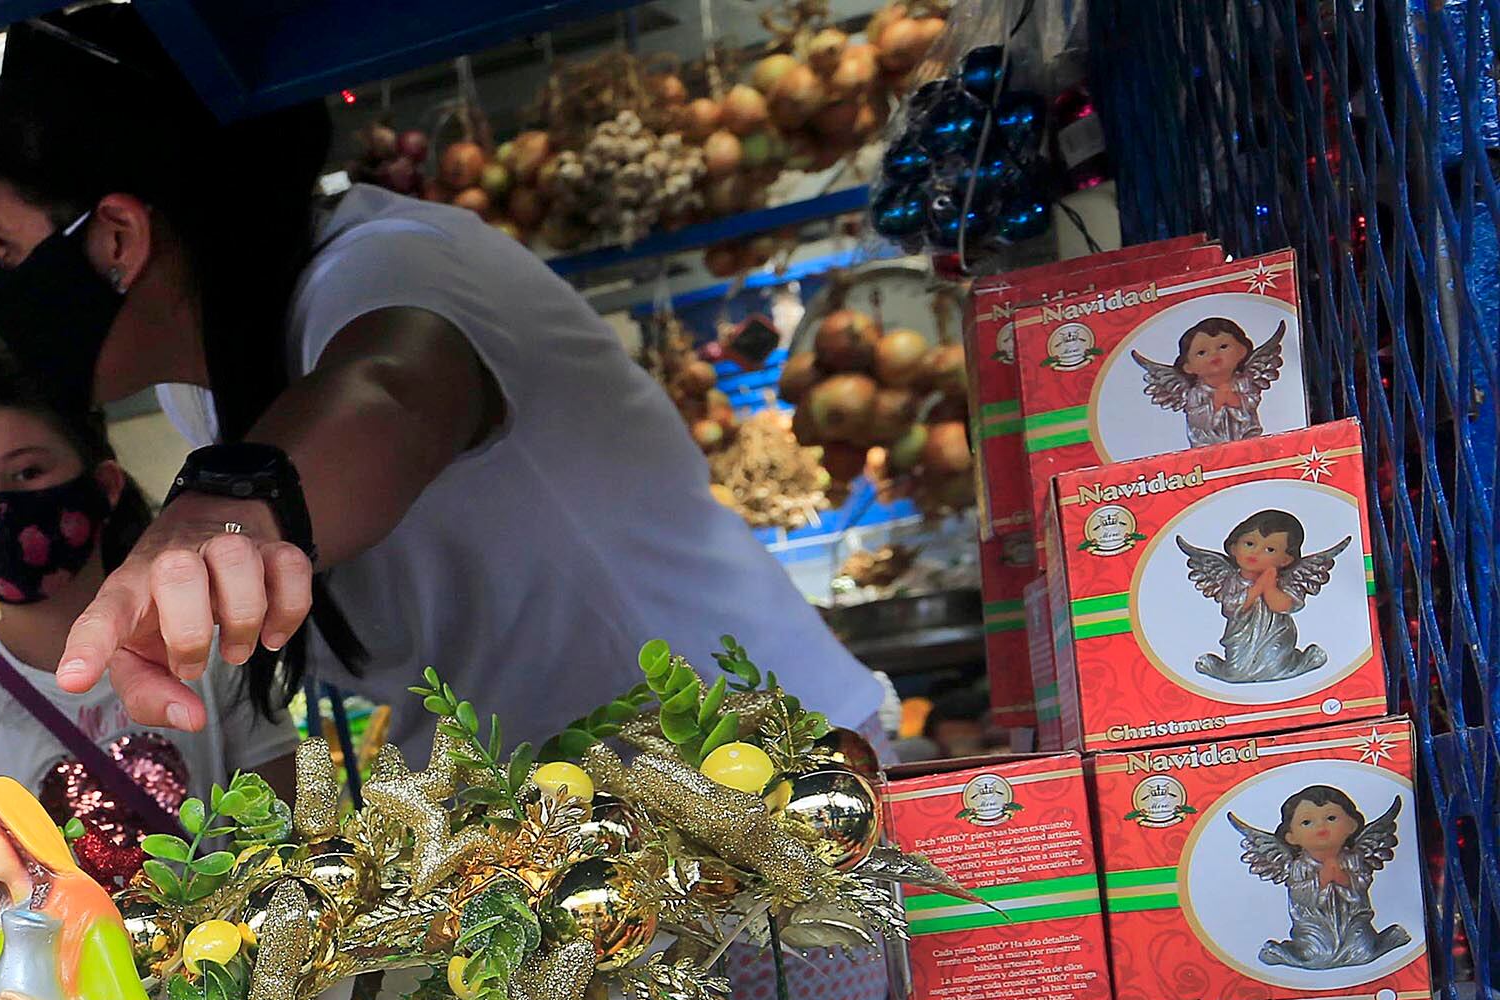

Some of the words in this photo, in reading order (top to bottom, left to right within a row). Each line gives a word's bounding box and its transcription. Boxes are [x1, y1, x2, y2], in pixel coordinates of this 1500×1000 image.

[1041, 281, 1158, 325] Navidad
[1077, 464, 1205, 506] Navidad
[1105, 716, 1226, 742] Christmas
[1125, 739, 1259, 775] Navidad
[915, 839, 936, 847] Each
[971, 831, 993, 841] piece
[1008, 827, 1029, 835] been
[952, 844, 963, 853] by
[964, 841, 985, 850] hand
[986, 840, 997, 849] by
[998, 838, 1012, 846] our
[1013, 833, 1046, 844] talented
[1047, 830, 1082, 839] artisans.
[981, 849, 997, 857] and
[998, 844, 1040, 855] dedication
[1041, 839, 1083, 851] guarantee
[1020, 854, 1041, 862] have
[1049, 849, 1078, 858] unique
[958, 871, 973, 880] will
[1007, 864, 1026, 874] ideal
[1027, 859, 1070, 871] decoration
[1071, 857, 1085, 866] for
[975, 879, 995, 888] your
[932, 948, 953, 957] Cada
[1010, 940, 1023, 948] Ha
[1024, 938, 1041, 946] sido
[1030, 949, 1045, 957] por
[1046, 944, 1081, 954] nuestros
[1008, 967, 1051, 977] dedicación
[1052, 964, 1063, 972] de
[1063, 963, 1083, 971] ellos
[966, 984, 981, 993] que
[982, 981, 1001, 990] cada
[1025, 987, 1041, 996] que
[1041, 984, 1050, 992] la
